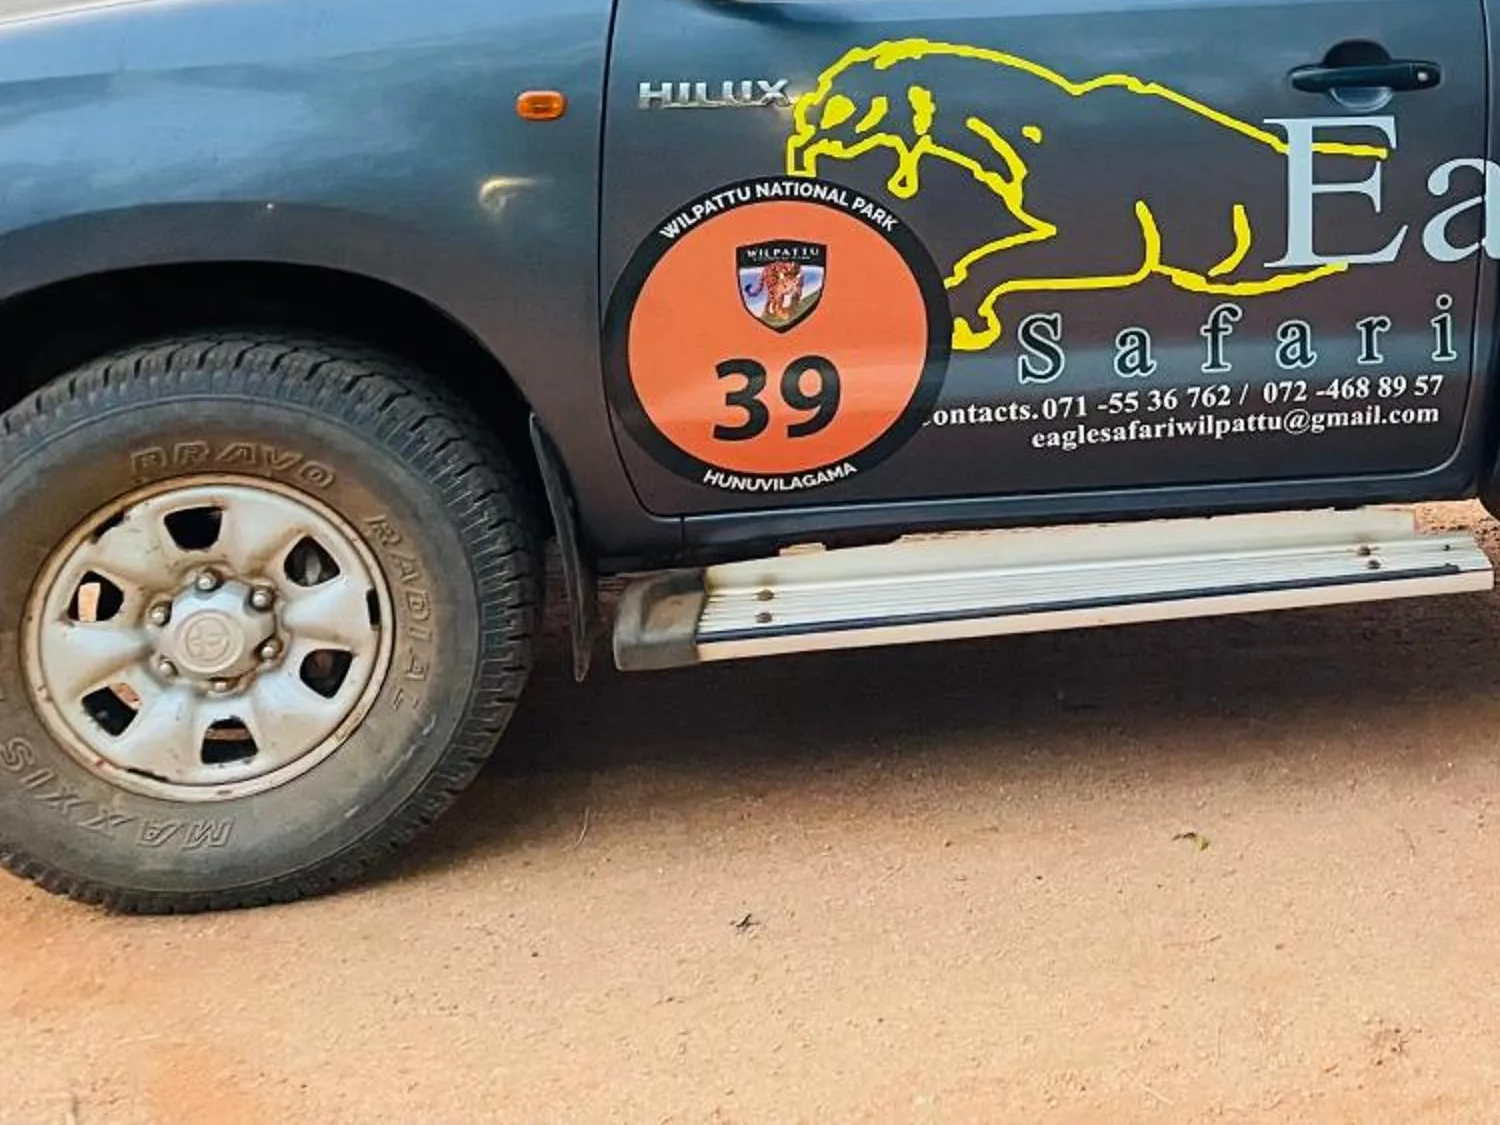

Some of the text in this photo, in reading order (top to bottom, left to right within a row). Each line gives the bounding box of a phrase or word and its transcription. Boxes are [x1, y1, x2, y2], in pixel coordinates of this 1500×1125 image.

[639, 79, 792, 109] HILUX
[660, 182, 899, 239] WILPATTU NATIONAL PARK
[747, 247, 819, 258] WILPATTU
[712, 355, 841, 441] 39
[1097, 390, 1139, 415] -55
[1147, 387, 1178, 413] 36
[1187, 384, 1231, 408] 762
[1263, 380, 1308, 404] 072
[1316, 376, 1370, 400] -468
[1378, 375, 1407, 398] 89
[1414, 374, 1444, 396] 57
[1031, 405, 1439, 452] eaglesafariwilpattu@gmail.com
[130, 440, 335, 491] BRAVO
[703, 461, 858, 493] HUNUVILAGAMA
[363, 512, 432, 713] RADIAL
[1, 735, 235, 851] MAXXIS
